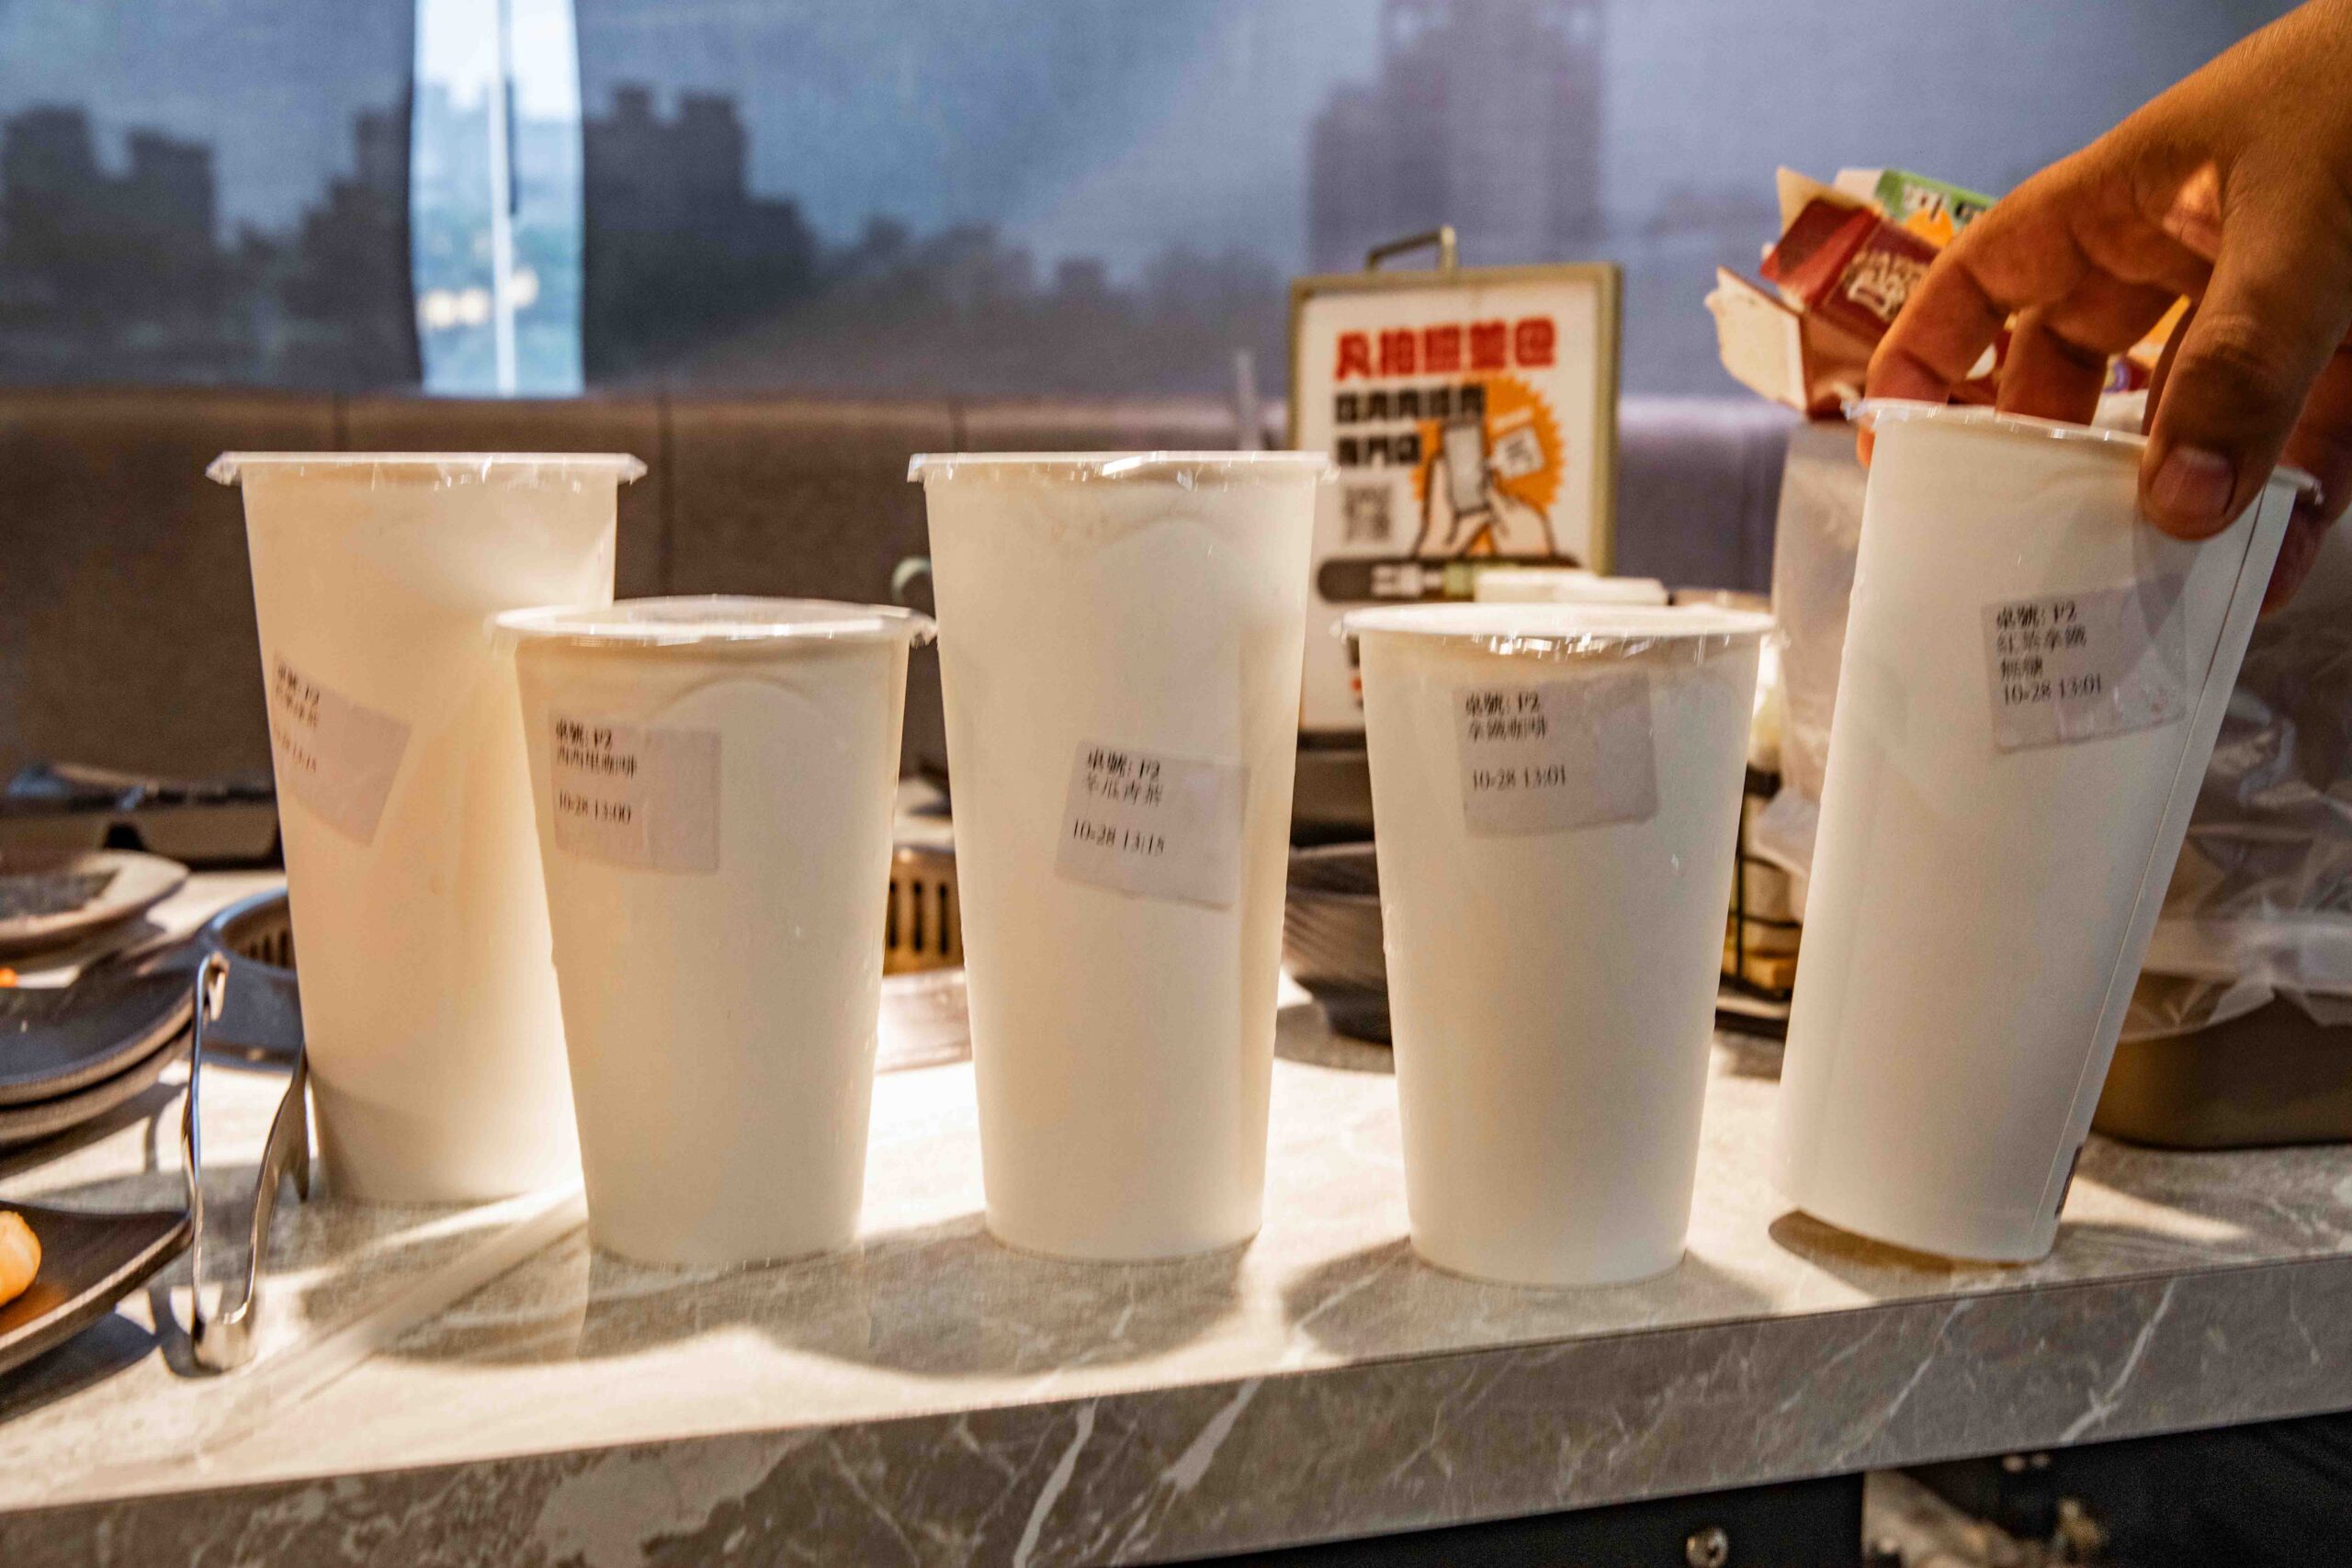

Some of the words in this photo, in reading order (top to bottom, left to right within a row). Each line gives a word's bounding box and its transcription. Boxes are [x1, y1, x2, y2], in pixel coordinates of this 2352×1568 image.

[2053, 600, 2078, 624] P2
[1518, 690, 1541, 715] P2
[2003, 682, 2052, 706] 10-28
[2059, 672, 2101, 699] 13:01
[1472, 768, 1516, 792] 10-28
[1524, 763, 1566, 790] 13:01
[1073, 818, 1117, 847] 10-28
